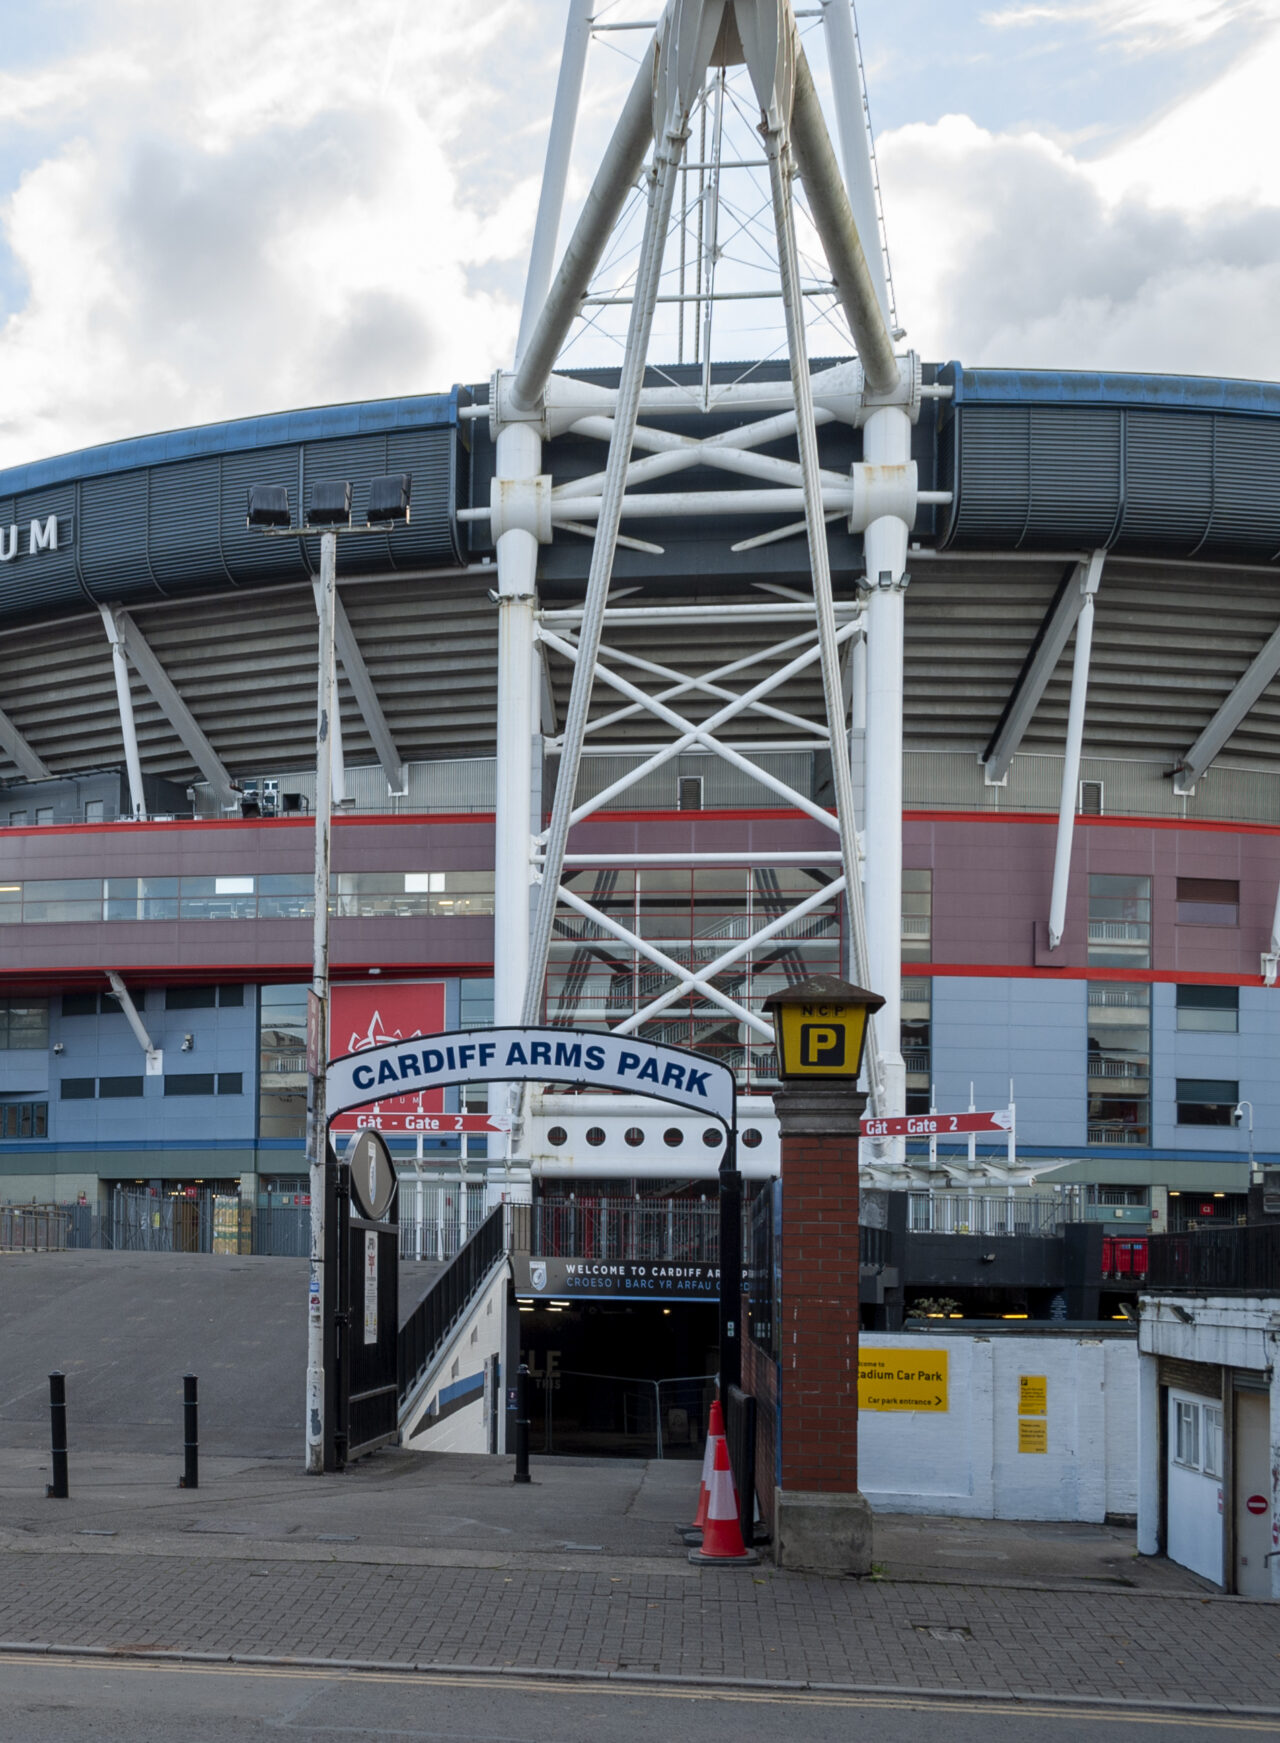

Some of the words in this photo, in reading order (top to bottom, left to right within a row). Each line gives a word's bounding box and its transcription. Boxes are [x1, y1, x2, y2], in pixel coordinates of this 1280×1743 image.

[801, 1005, 844, 1016] NCP
[808, 1027, 837, 1063] P
[351, 1043, 497, 1090] CARDIFF
[505, 1041, 605, 1071] ARMS
[616, 1051, 713, 1097] PARK
[356, 1115, 382, 1129] Gât
[405, 1116, 440, 1129] Gate
[454, 1116, 463, 1129] 2
[865, 1120, 888, 1134] Gât
[907, 1119, 937, 1133] Gate
[949, 1117, 958, 1130] 2
[566, 1264, 625, 1275] WELCOME
[631, 1266, 646, 1276] TO
[651, 1267, 702, 1278] CARDIFF
[566, 1277, 612, 1288] CROESO
[625, 1279, 654, 1289] BARC
[659, 1280, 672, 1289] YR
[677, 1280, 711, 1290] ARFAU
[897, 1370, 915, 1380] Car
[918, 1370, 943, 1381] Park
[867, 1396, 880, 1404] Car
[881, 1397, 898, 1406] park
[899, 1398, 932, 1406] entrance
